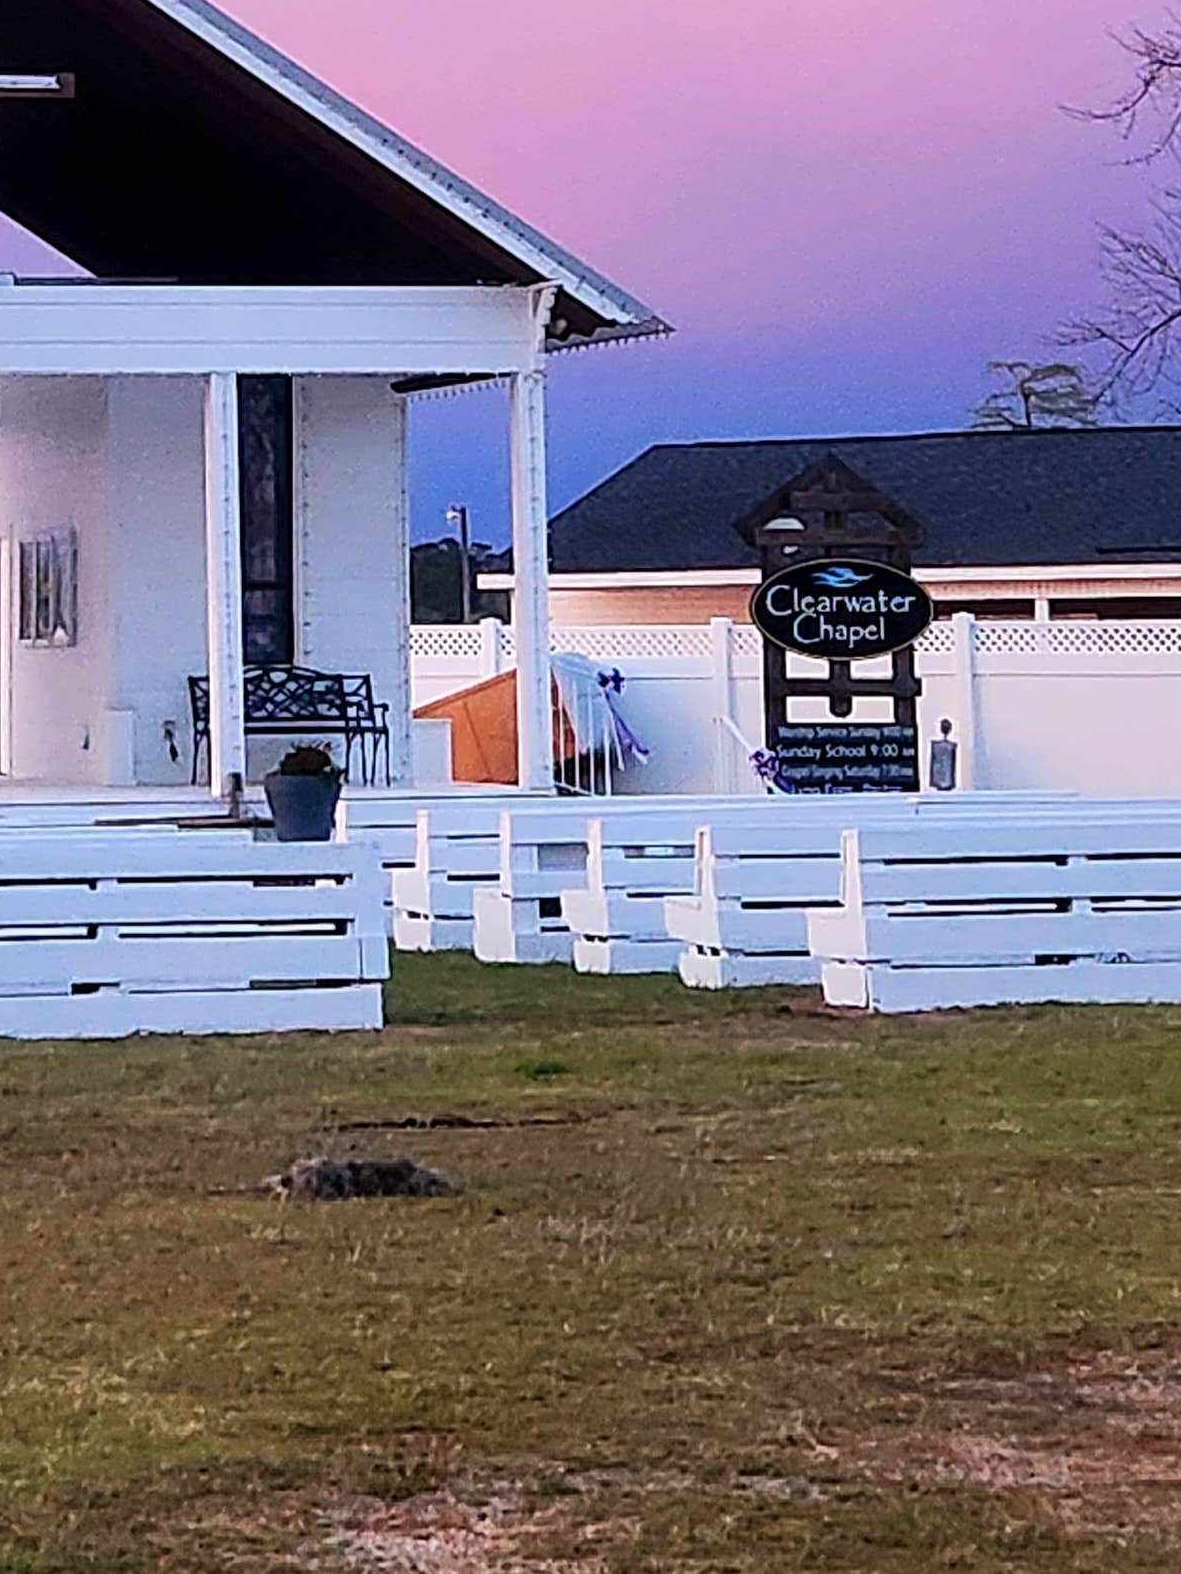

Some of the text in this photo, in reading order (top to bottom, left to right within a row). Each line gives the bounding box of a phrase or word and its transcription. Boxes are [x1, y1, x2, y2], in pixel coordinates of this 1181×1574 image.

[765, 584, 917, 616] Clearwater
[793, 610, 886, 649] Chapel
[815, 726, 847, 738] Service
[776, 743, 821, 761] Sunday
[825, 743, 866, 758] School
[870, 743, 899, 757] 9:00
